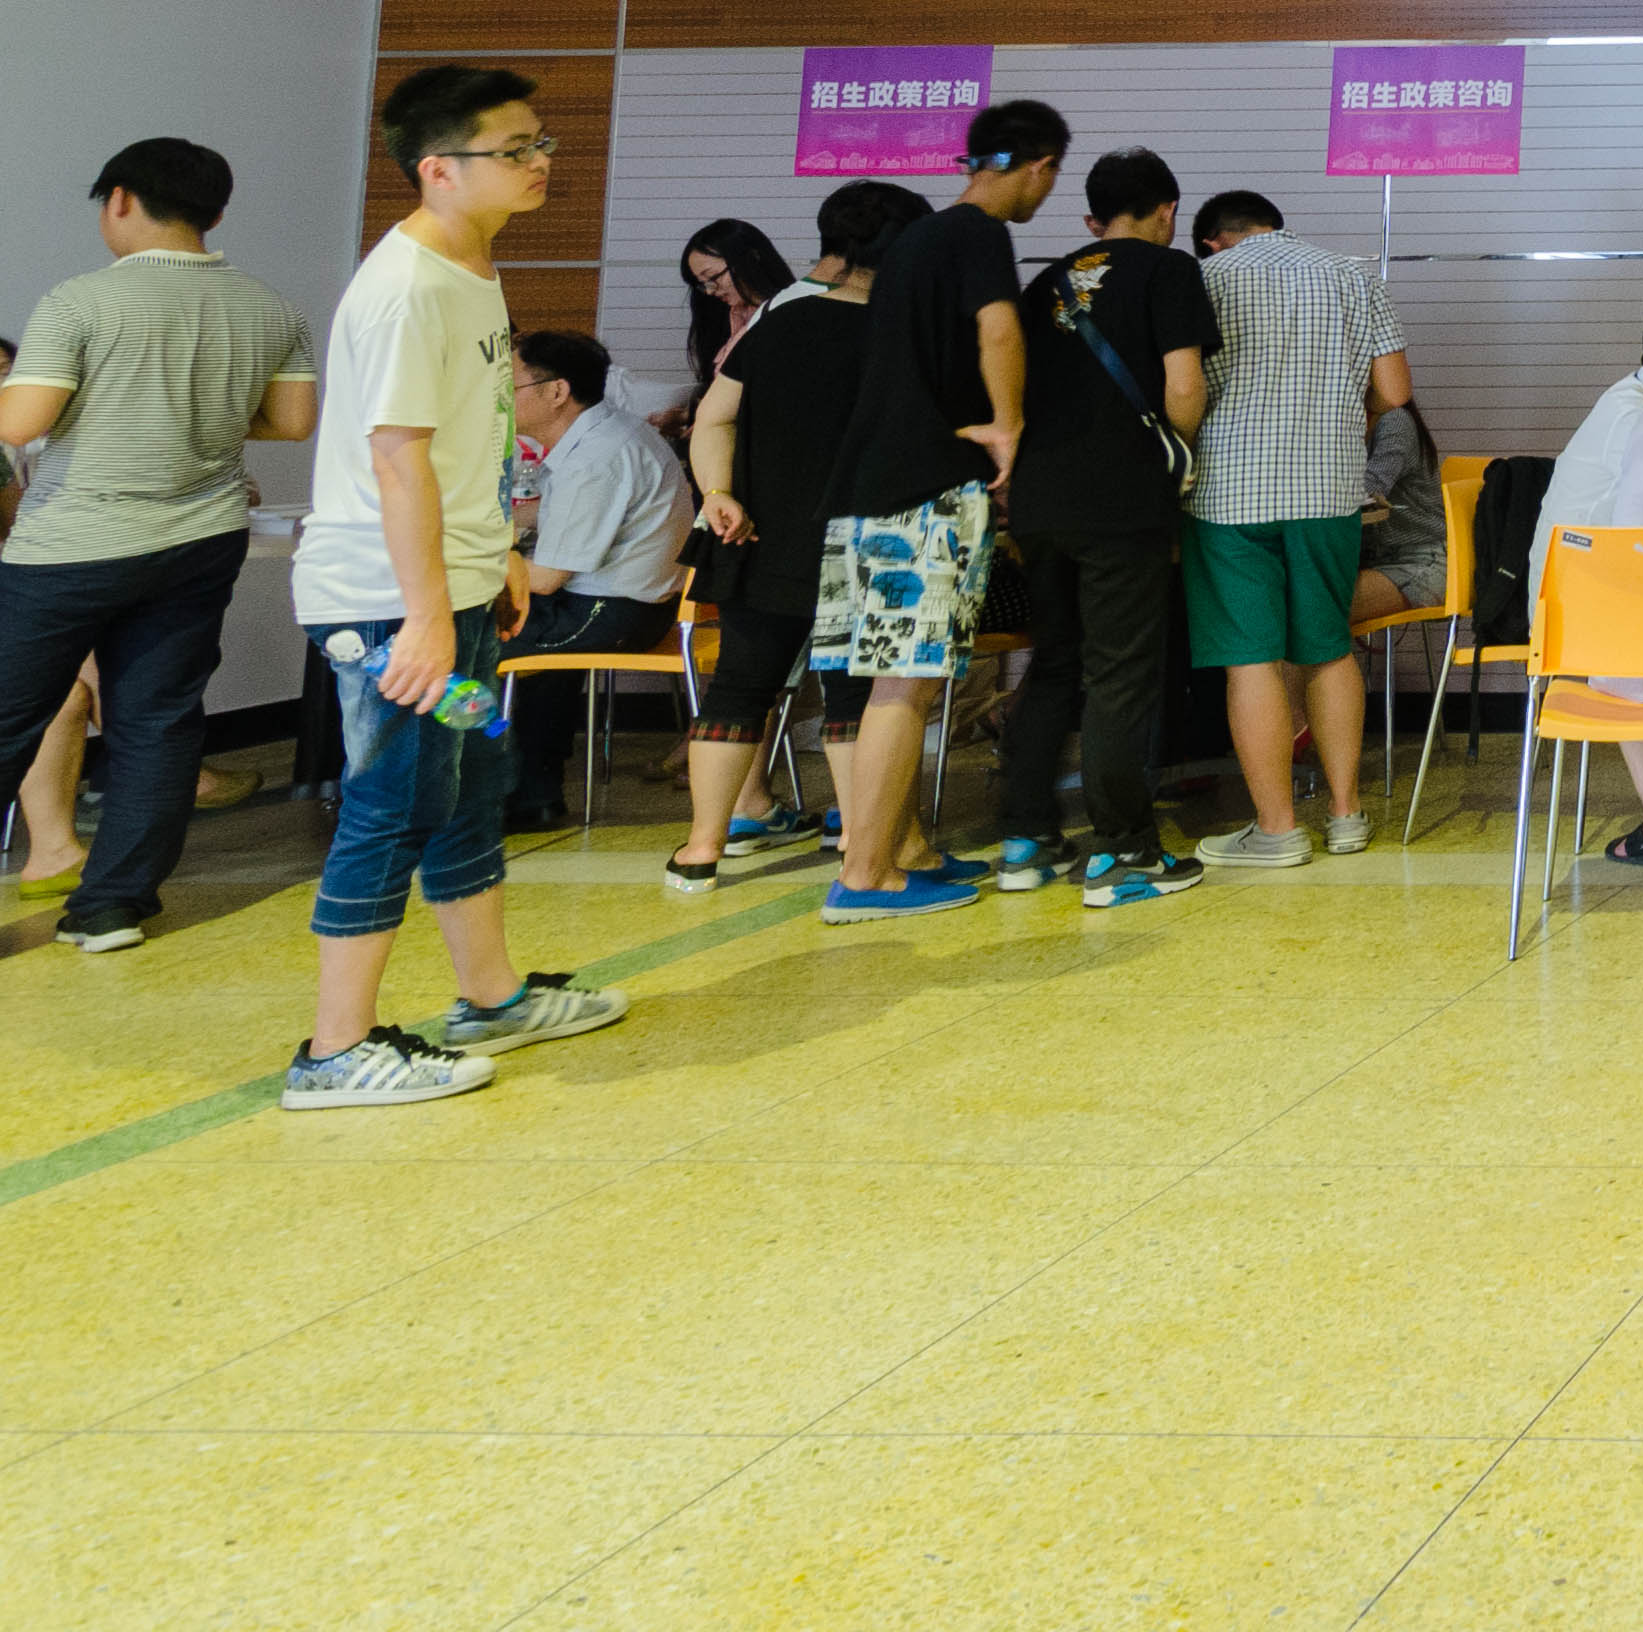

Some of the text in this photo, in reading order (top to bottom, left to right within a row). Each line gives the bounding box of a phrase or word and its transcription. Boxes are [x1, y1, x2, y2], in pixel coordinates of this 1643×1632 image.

[811, 79, 980, 109] 招生政策咨询
[1342, 79, 1513, 109] 招生政策咨询
